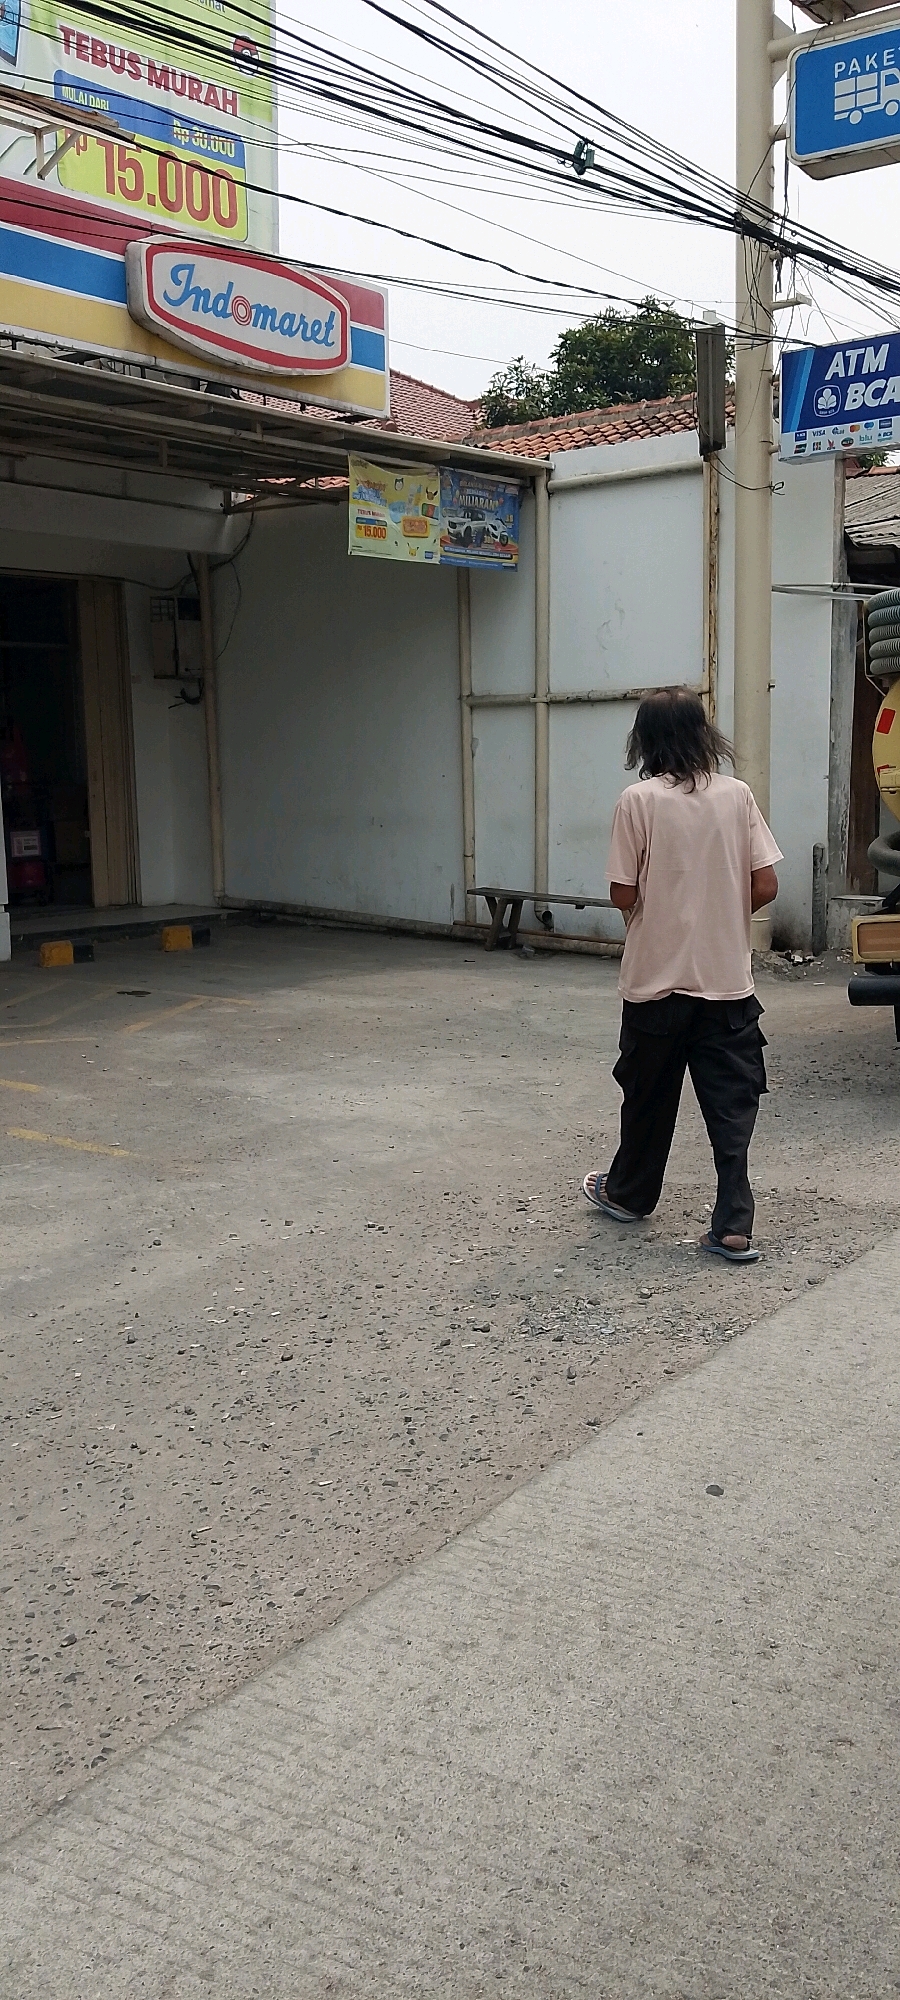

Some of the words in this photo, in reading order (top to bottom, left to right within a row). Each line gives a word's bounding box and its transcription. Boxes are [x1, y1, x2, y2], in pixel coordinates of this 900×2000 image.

[59, 24, 142, 81] TEBUS
[147, 58, 238, 117] MURAH
[834, 47, 900, 79] PAKE
[62, 86, 88, 106] MULAI
[89, 94, 110, 111] DARI
[173, 118, 190, 146] Rp
[96, 136, 239, 229] 15.000
[163, 263, 336, 348] Indomaret
[824, 343, 890, 381] ATM
[844, 375, 900, 411] BCA
[812, 429, 826, 437] VISA
[363, 525, 387, 540] 15.000
